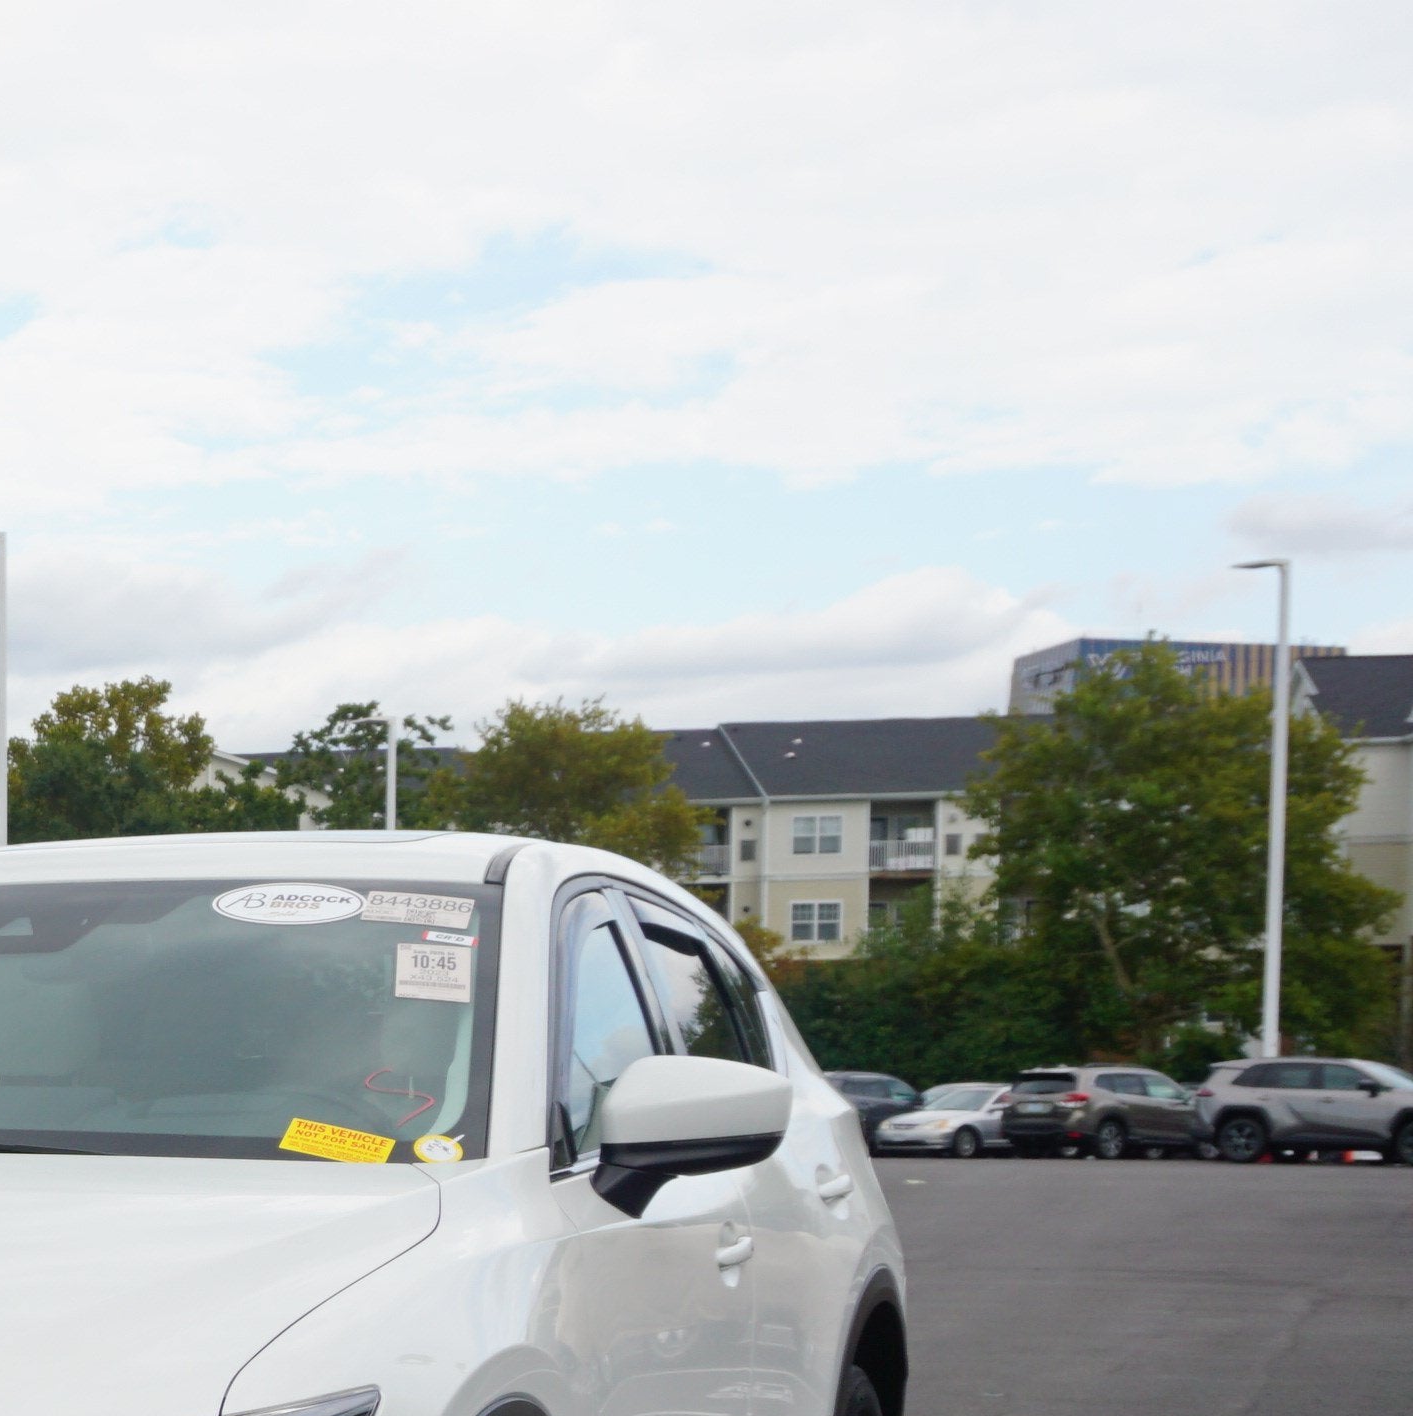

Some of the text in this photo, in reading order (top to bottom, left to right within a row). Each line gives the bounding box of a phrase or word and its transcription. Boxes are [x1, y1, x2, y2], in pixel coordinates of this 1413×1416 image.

[269, 900, 321, 909] BROS
[273, 894, 354, 904] ADCOCK
[370, 894, 473, 913] 8443886
[411, 954, 457, 971] 10:45
[295, 1129, 318, 1138] NOT
[322, 1134, 347, 1145] FOR
[350, 1142, 382, 1153] SALE
[296, 1120, 389, 1148] THIS VEHICLE
